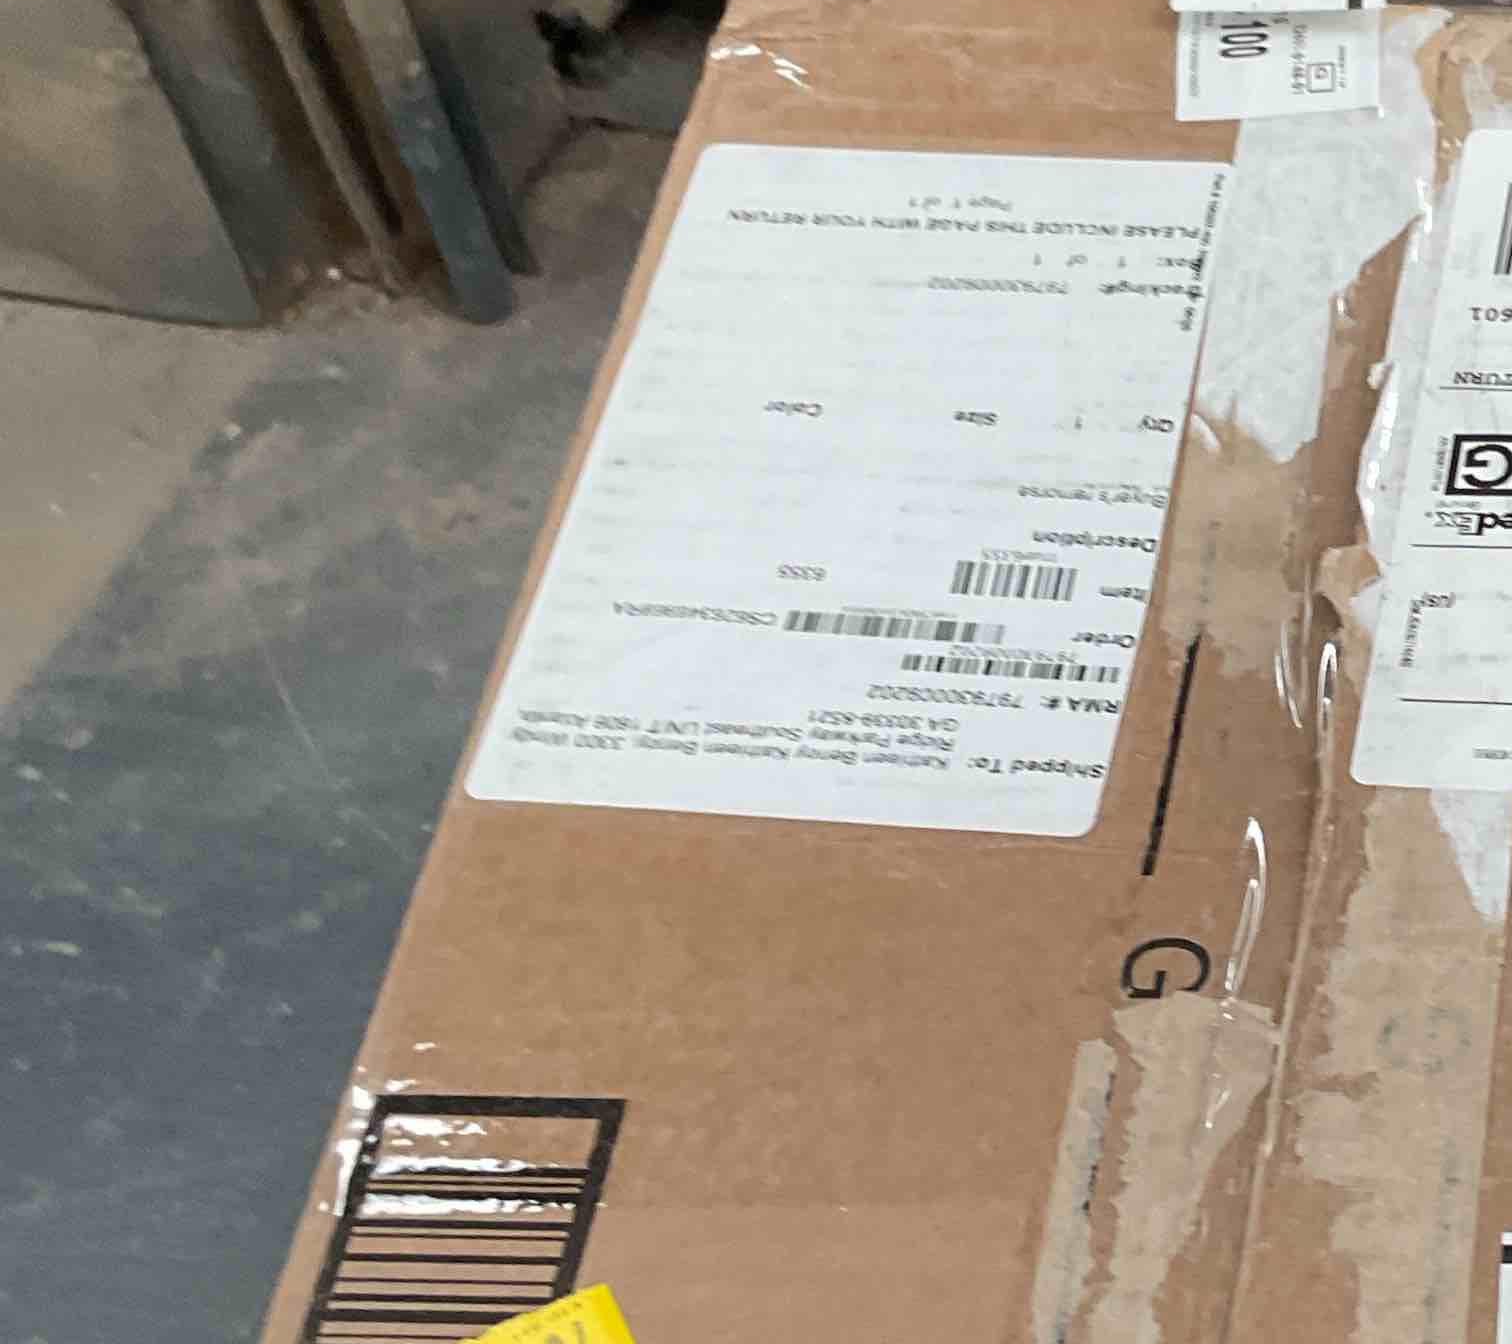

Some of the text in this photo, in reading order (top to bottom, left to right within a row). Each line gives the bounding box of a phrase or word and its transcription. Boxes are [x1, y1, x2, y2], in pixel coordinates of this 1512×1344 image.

[727, 207, 1200, 239] PLEASE INCLUDE THIS PAGE WITH YOUR RETURN
[762, 399, 824, 418] Color
[952, 409, 997, 426] Size
[1138, 414, 1175, 434] Qty
[1032, 532, 1156, 553] Description
[1070, 631, 1135, 650] Order
[1065, 696, 1120, 714] RMA
[967, 757, 1002, 775] To:
[1009, 758, 1105, 781] Shipped
